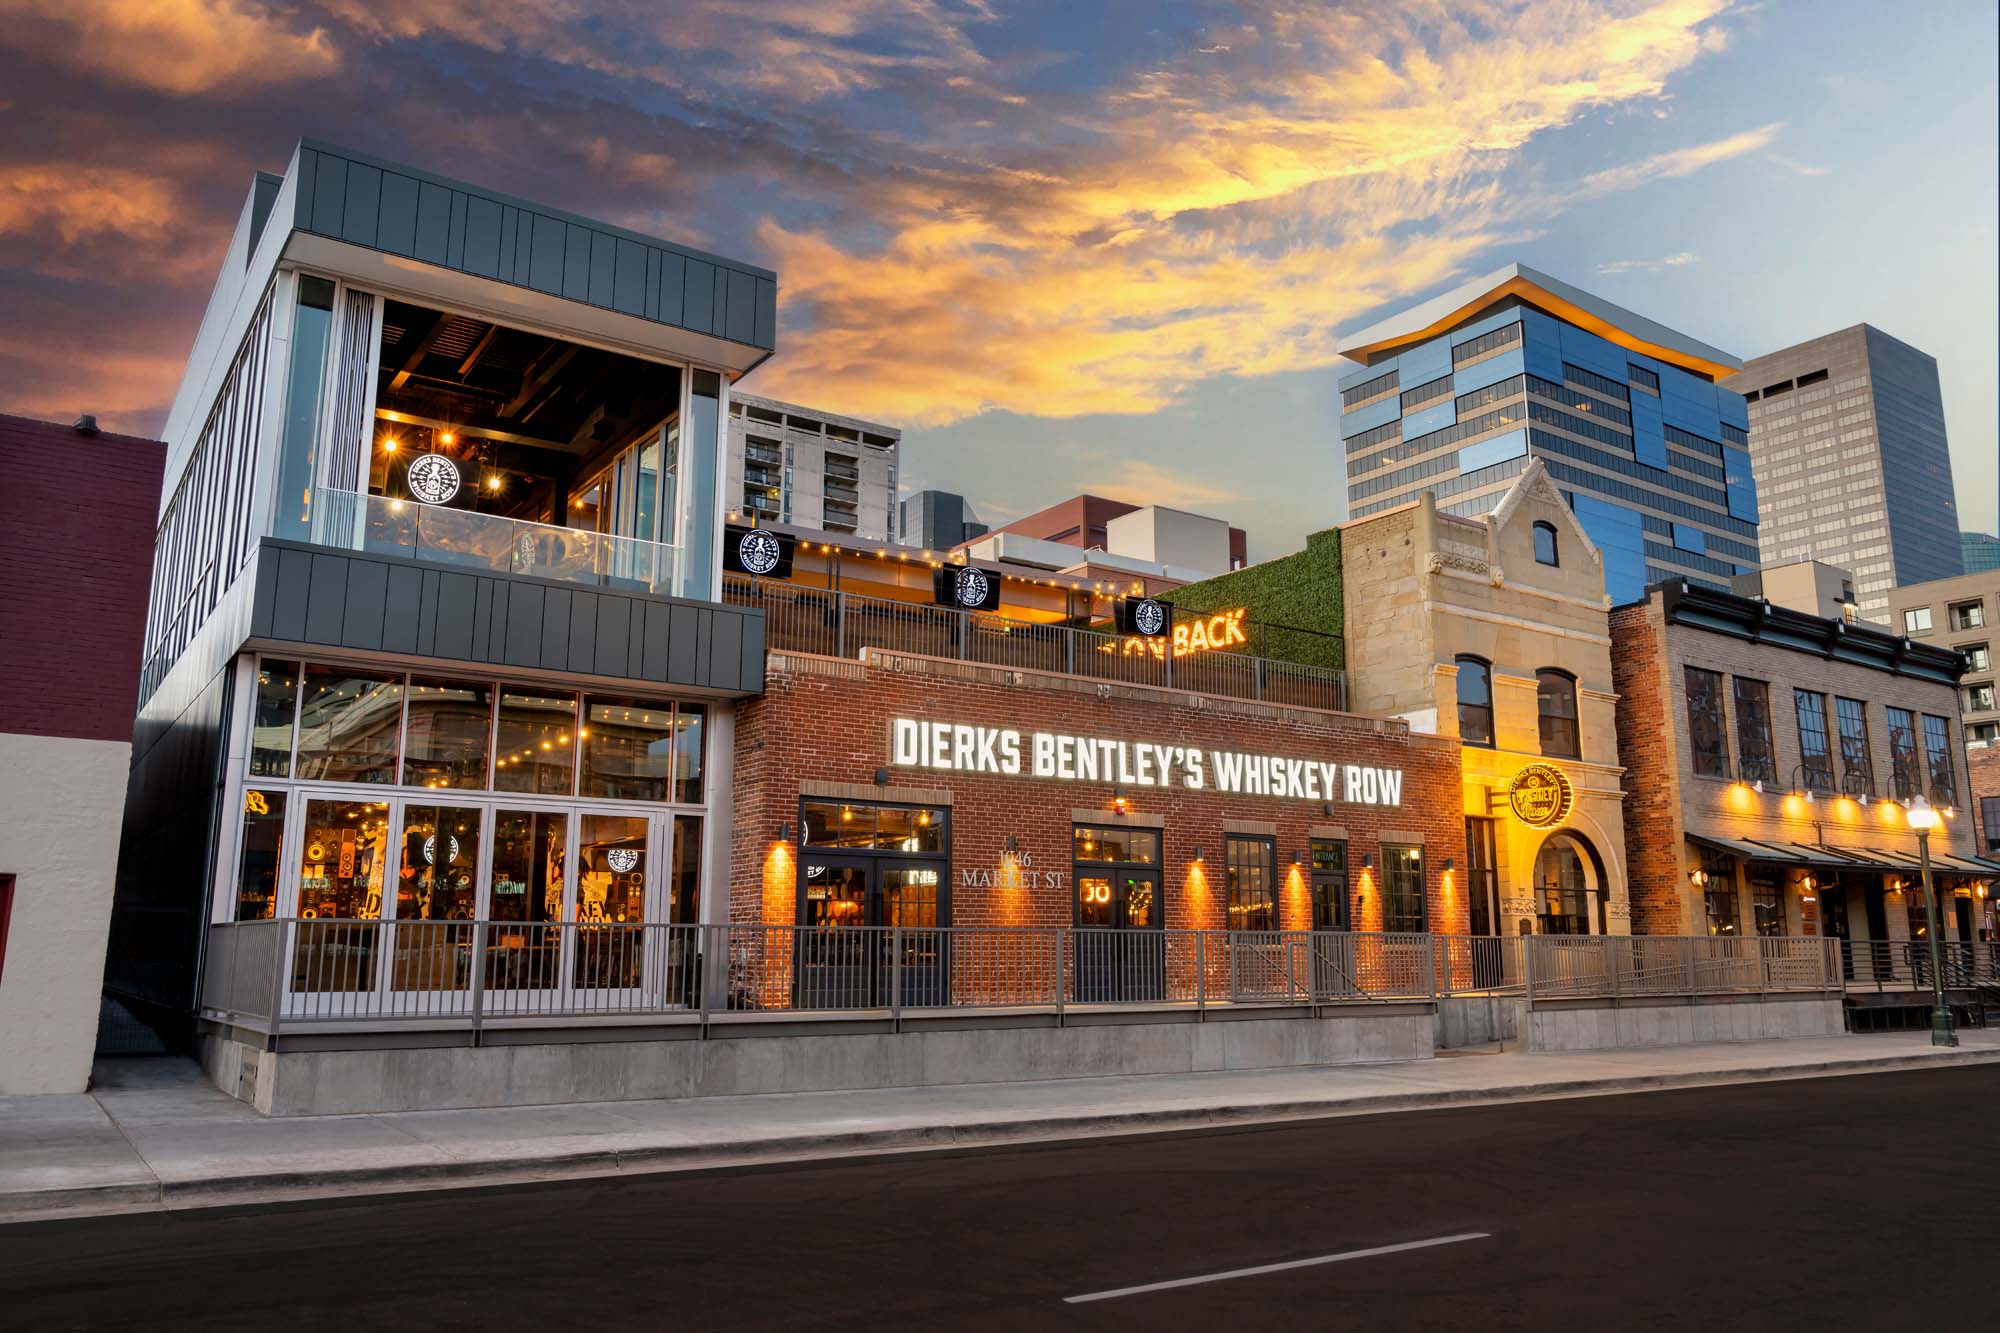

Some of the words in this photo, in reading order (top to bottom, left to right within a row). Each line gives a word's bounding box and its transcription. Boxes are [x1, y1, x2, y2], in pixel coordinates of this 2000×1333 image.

[412, 480, 440, 501] WHISKEY
[441, 486, 454, 499] ROW
[1173, 607, 1248, 657] BACK
[892, 717, 1022, 776] DIERKS
[1031, 731, 1205, 790] BENTLEY'S
[1211, 750, 1337, 801] WHISKEY
[1343, 764, 1403, 807] ROW
[961, 868, 1040, 889] MARKET
[1045, 871, 1065, 889] ST
